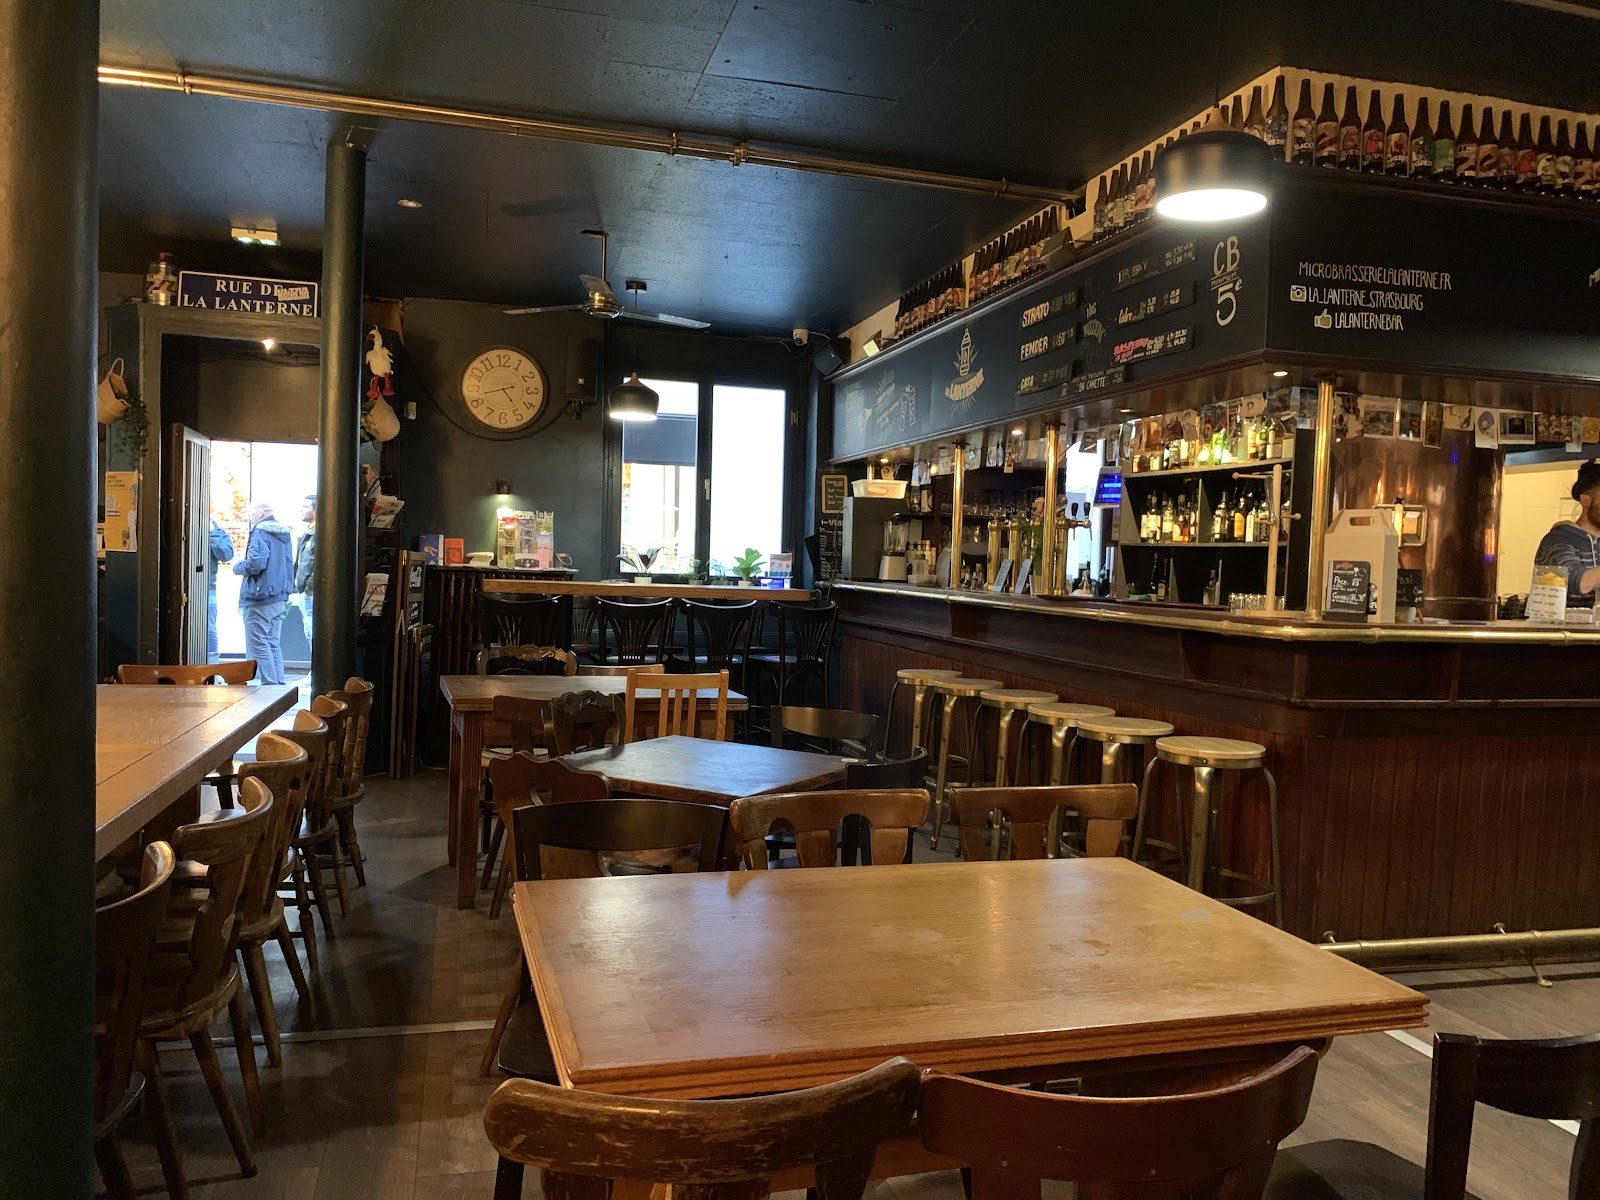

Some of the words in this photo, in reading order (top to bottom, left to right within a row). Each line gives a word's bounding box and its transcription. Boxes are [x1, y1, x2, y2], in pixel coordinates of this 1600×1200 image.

[1213, 235, 1240, 276] CB
[215, 279, 252, 295] RUE
[183, 293, 208, 308] LA
[215, 296, 313, 317] LANTERNE
[1021, 301, 1050, 328] STRATO
[1335, 311, 1404, 331] LALANTERNEBAR
[1020, 335, 1050, 361] FENDER
[496, 354, 511, 368] 12
[521, 371, 535, 383] 2
[525, 387, 539, 395] 3
[499, 411, 508, 425] 6
[512, 408, 524, 422] 5
